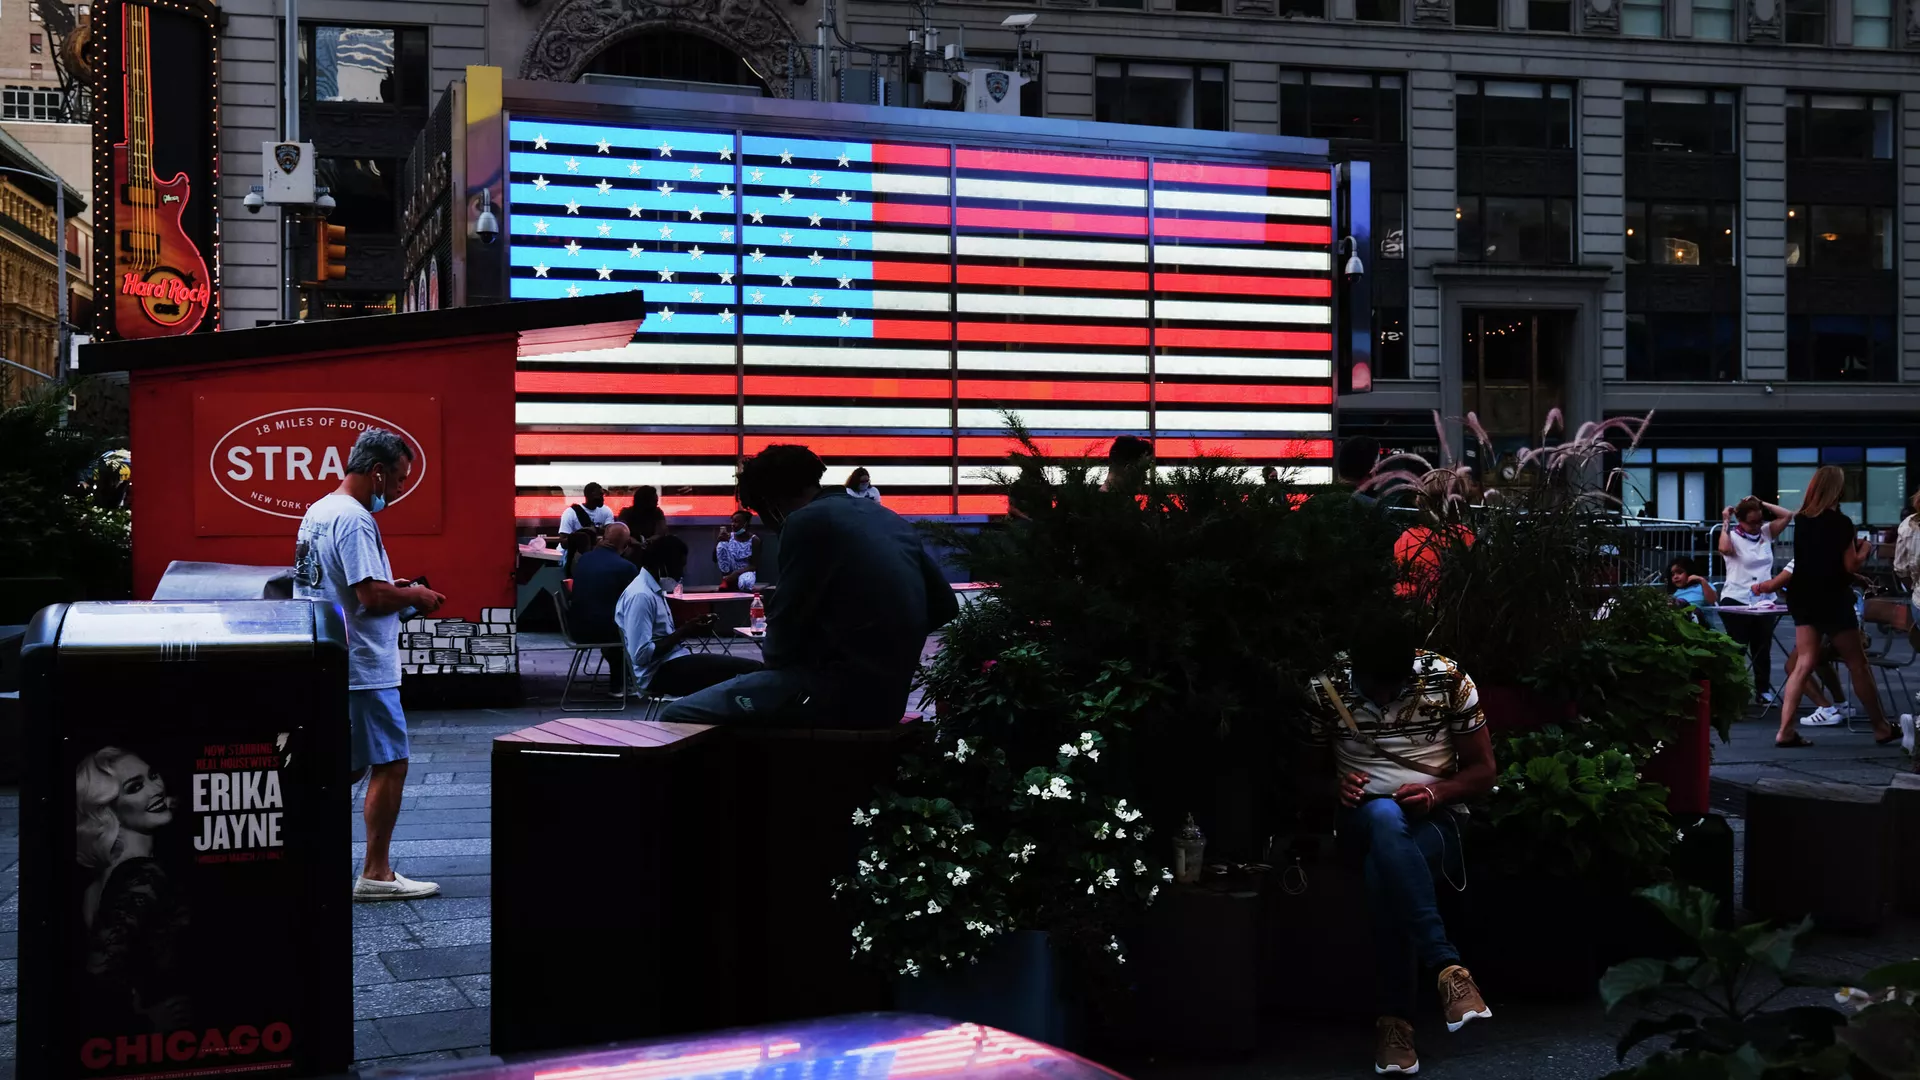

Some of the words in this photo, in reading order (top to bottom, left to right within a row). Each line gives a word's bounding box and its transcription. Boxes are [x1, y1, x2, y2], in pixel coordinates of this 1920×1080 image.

[122, 272, 168, 298] Hard
[168, 278, 208, 308] Rock
[255, 424, 271, 436] 18
[275, 416, 314, 431] MILES
[319, 416, 335, 427] OF
[227, 445, 358, 482] STRA
[250, 491, 272, 504] NEW
[276, 498, 301, 509] YORK
[195, 758, 218, 770] REAL
[220, 755, 280, 770] HOUSEWIVES
[203, 744, 226, 757] NOW
[228, 742, 273, 756] STARRING
[192, 770, 284, 812] ERIKA
[193, 812, 284, 851] JAYNE
[80, 1021, 292, 1070] CHICAGO
